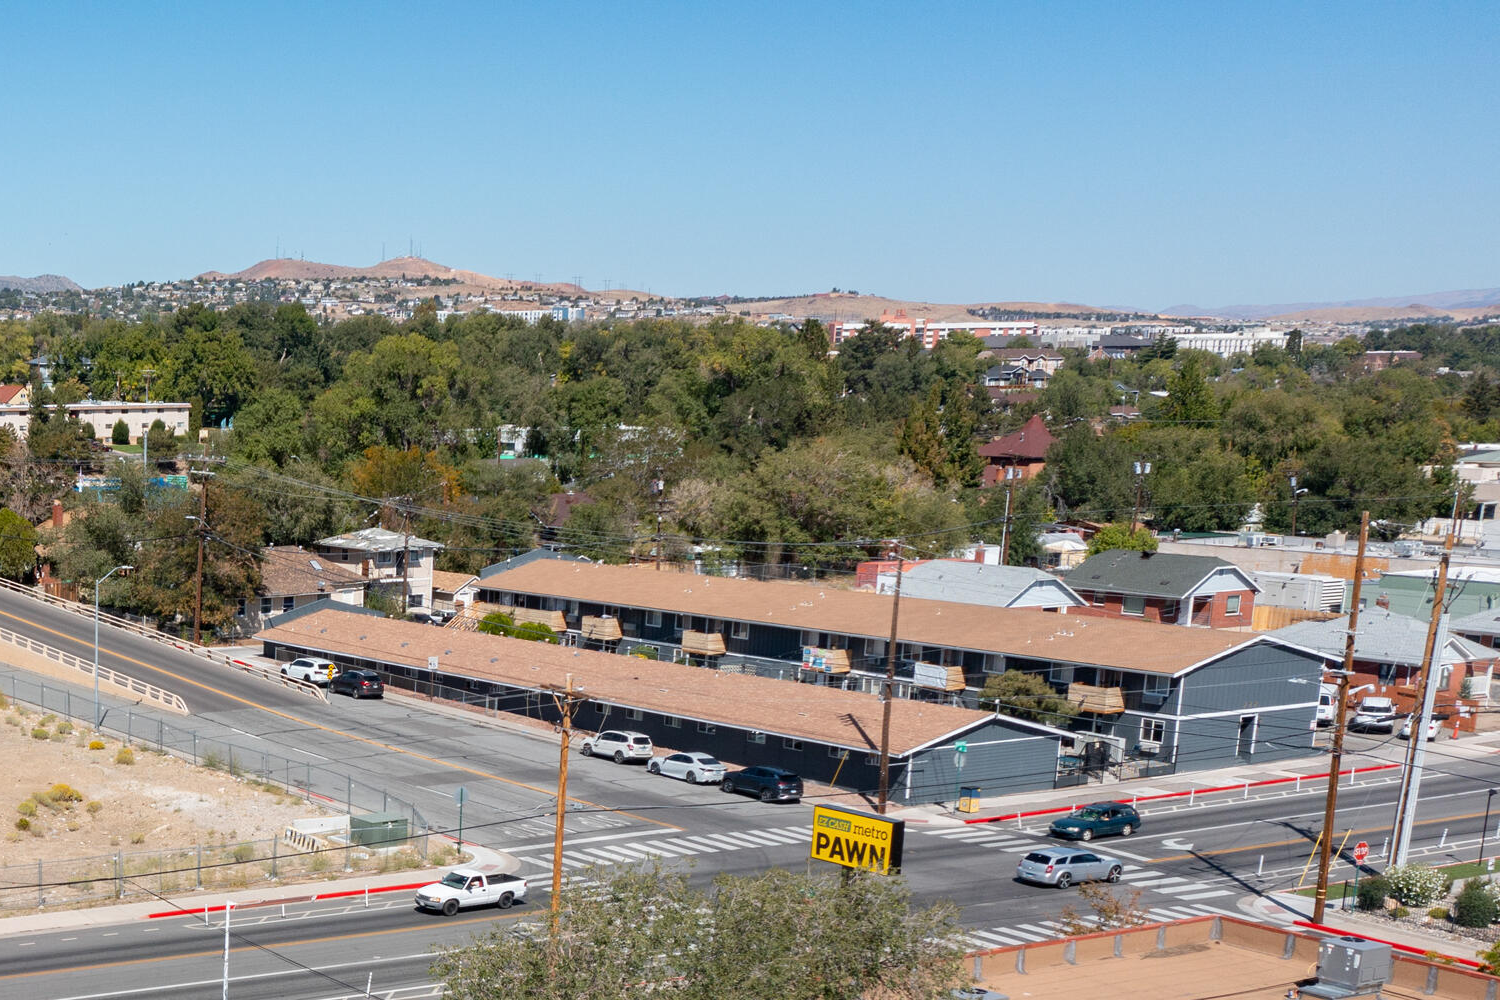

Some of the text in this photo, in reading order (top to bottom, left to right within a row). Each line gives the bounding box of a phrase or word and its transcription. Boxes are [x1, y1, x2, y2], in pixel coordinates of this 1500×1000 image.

[828, 818, 850, 832] CASH
[853, 824, 888, 841] metro
[816, 832, 886, 871] PAWN
